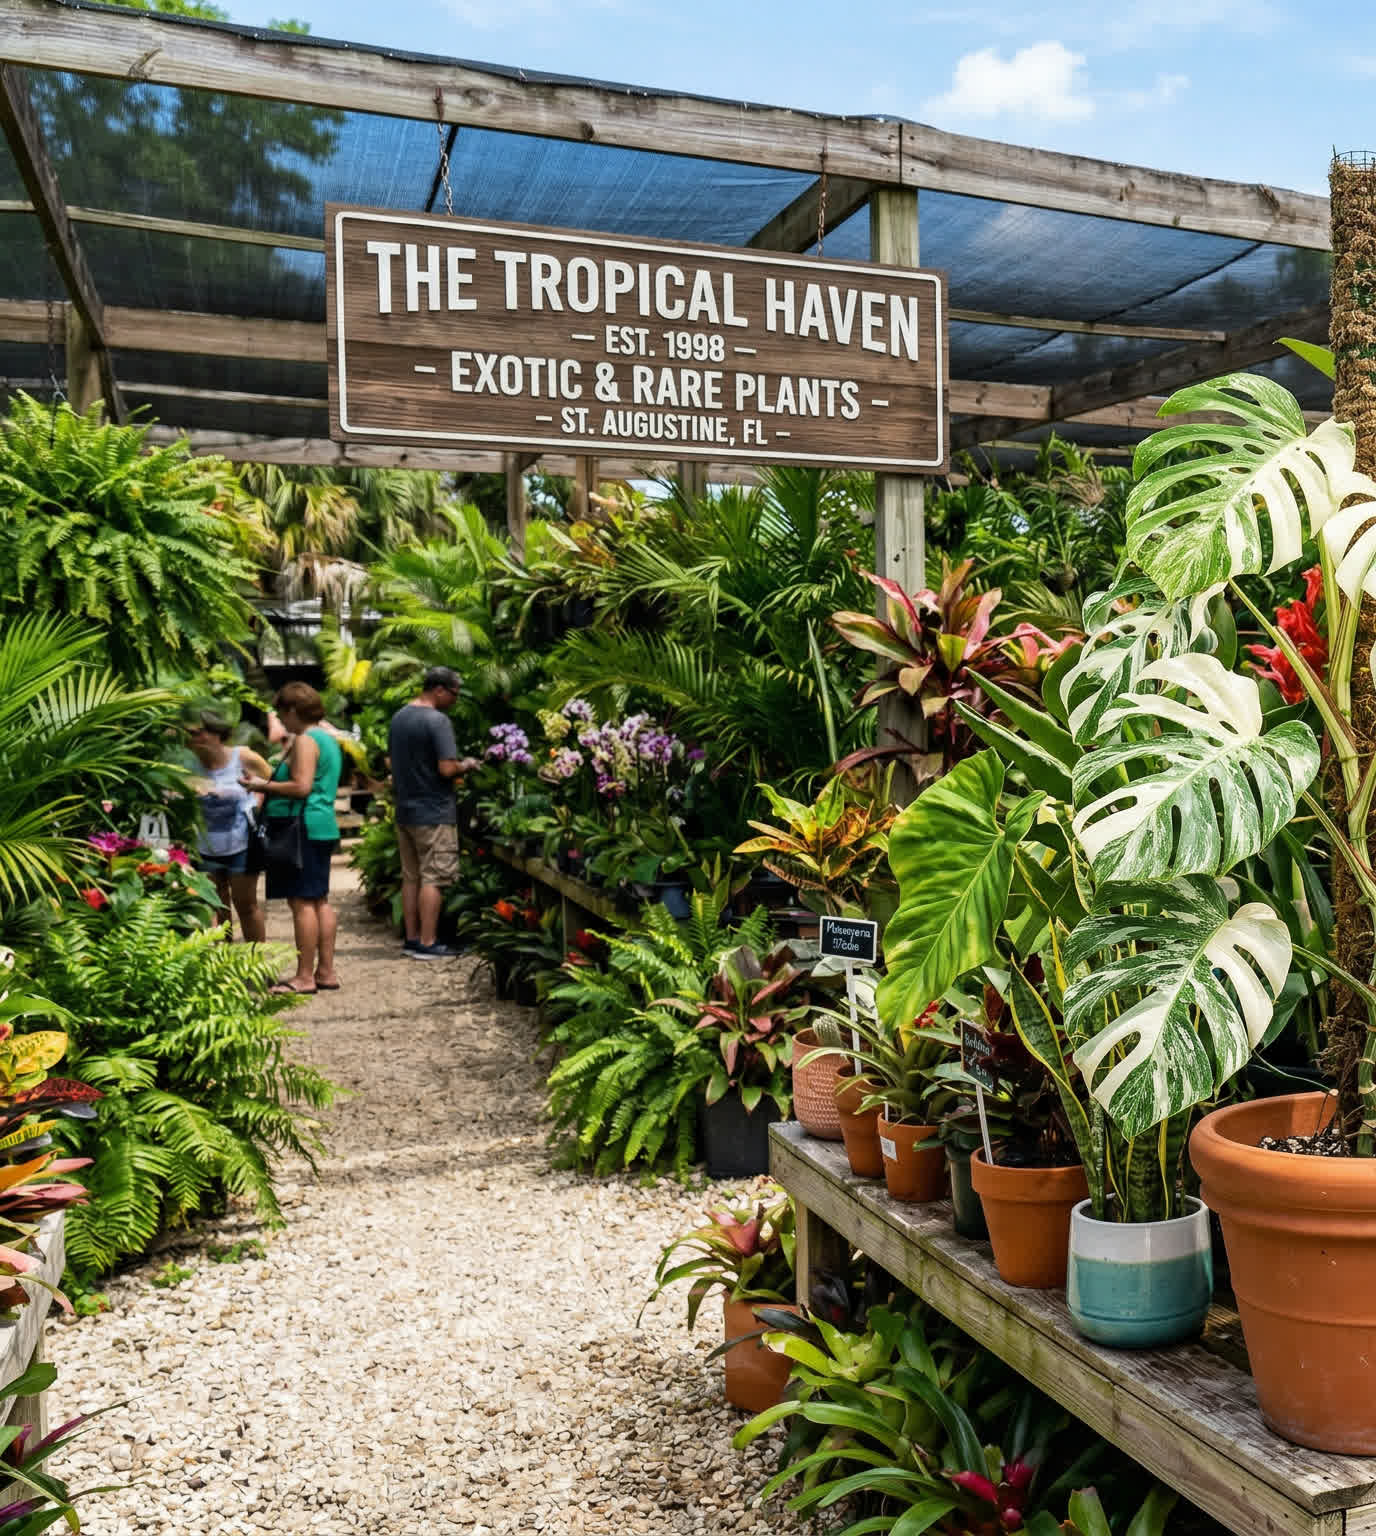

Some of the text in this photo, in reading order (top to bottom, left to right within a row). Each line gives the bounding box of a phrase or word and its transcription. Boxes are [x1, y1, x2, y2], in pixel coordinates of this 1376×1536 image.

[366, 240, 920, 362] THE TROPICAL HAVEN
[605, 325, 726, 362] EST. 1998
[450, 350, 861, 420] EXOTIC & RARE PLANTS
[560, 407, 769, 446] ST. AUGUSTINE, FL
